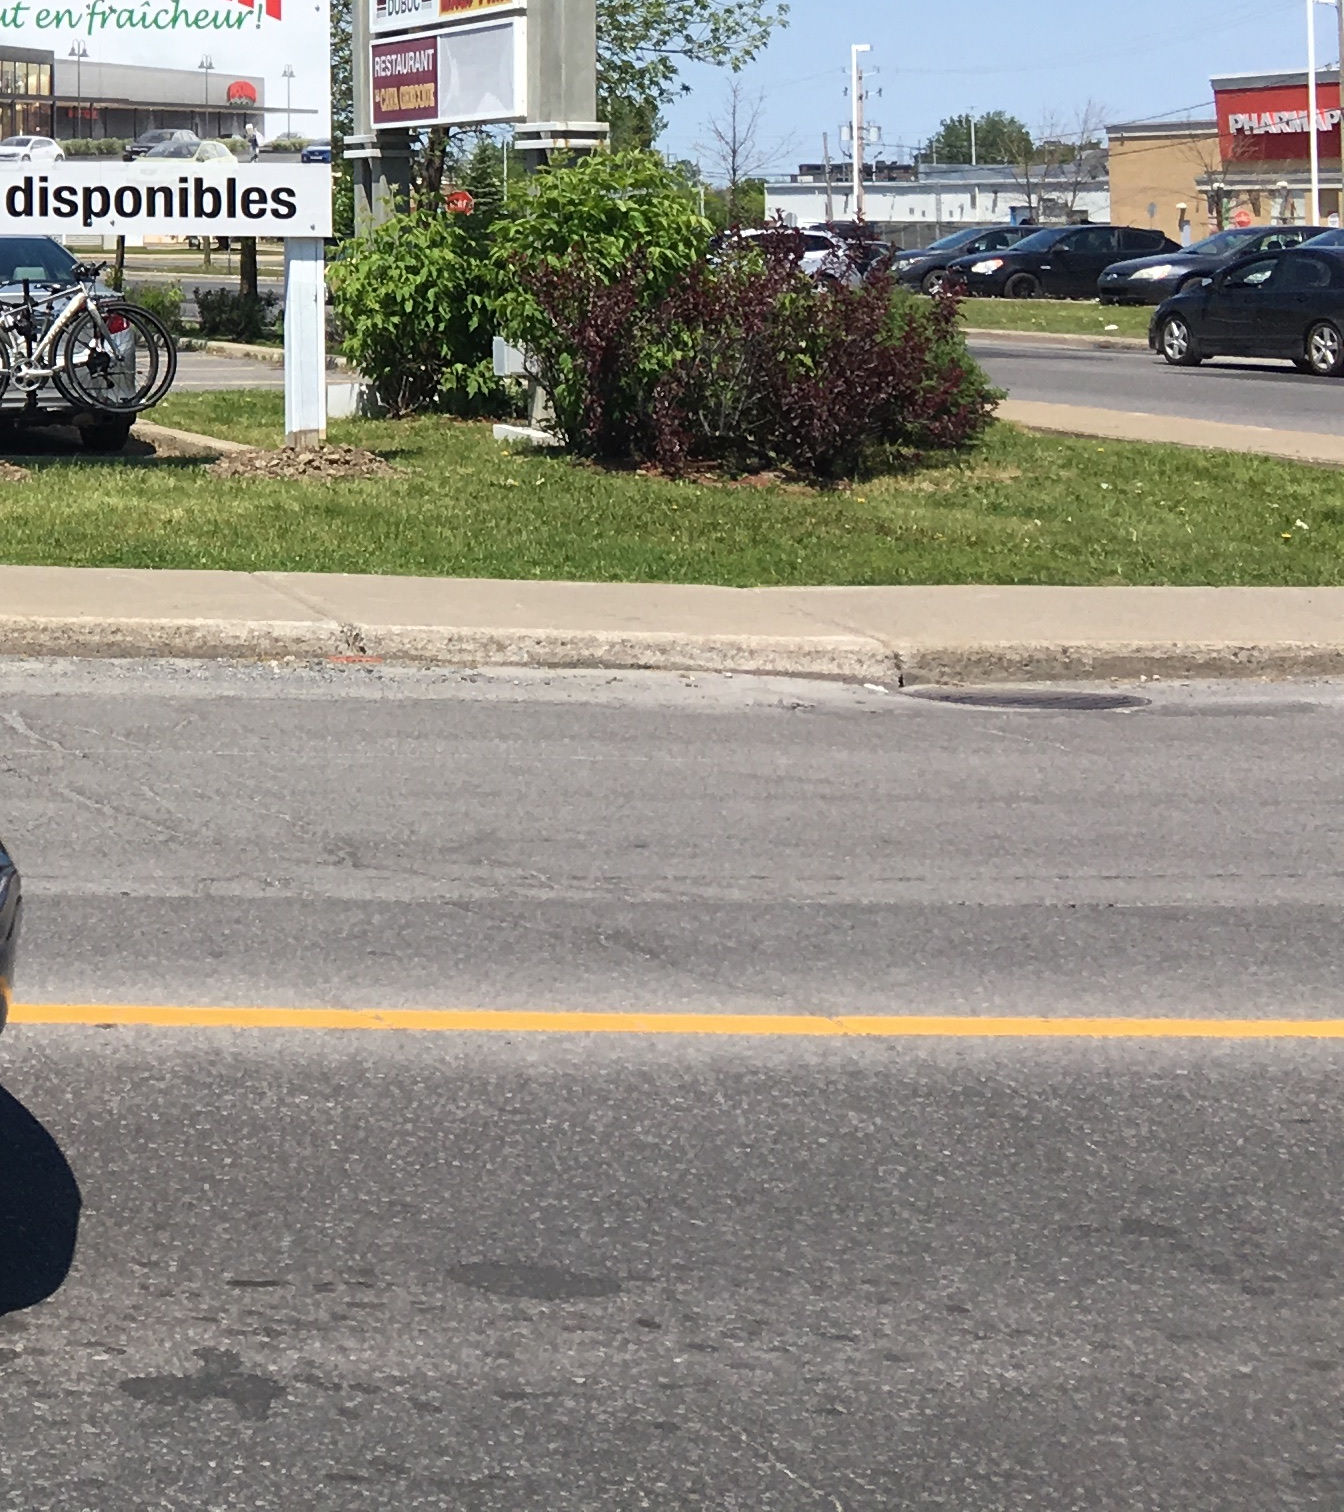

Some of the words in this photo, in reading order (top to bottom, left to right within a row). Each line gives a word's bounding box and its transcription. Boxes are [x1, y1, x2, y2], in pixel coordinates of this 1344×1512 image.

[35, 7, 83, 30] en
[375, 48, 434, 78] RESTAURANT
[21, 174, 298, 226] disponibles
